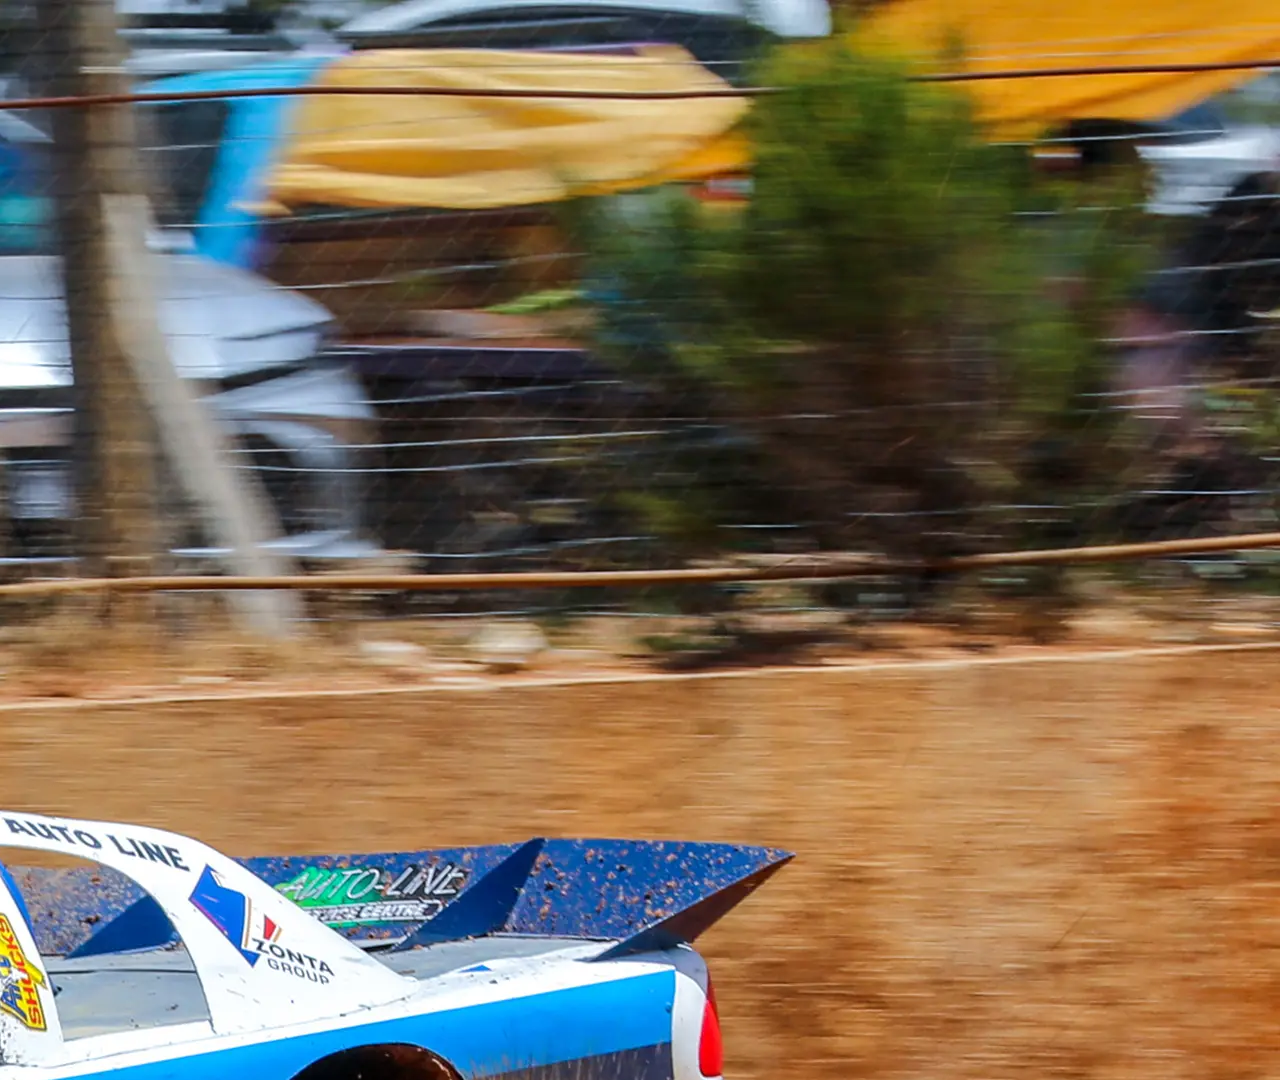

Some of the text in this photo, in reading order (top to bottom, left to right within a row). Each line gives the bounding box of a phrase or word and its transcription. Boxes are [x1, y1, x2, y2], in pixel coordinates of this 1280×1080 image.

[2, 818, 190, 871] AUTO LINE
[283, 864, 466, 901] AUTO-LINE
[359, 902, 429, 918] CENTRE
[251, 938, 334, 976] ZONTA
[267, 958, 331, 986] GROUP
